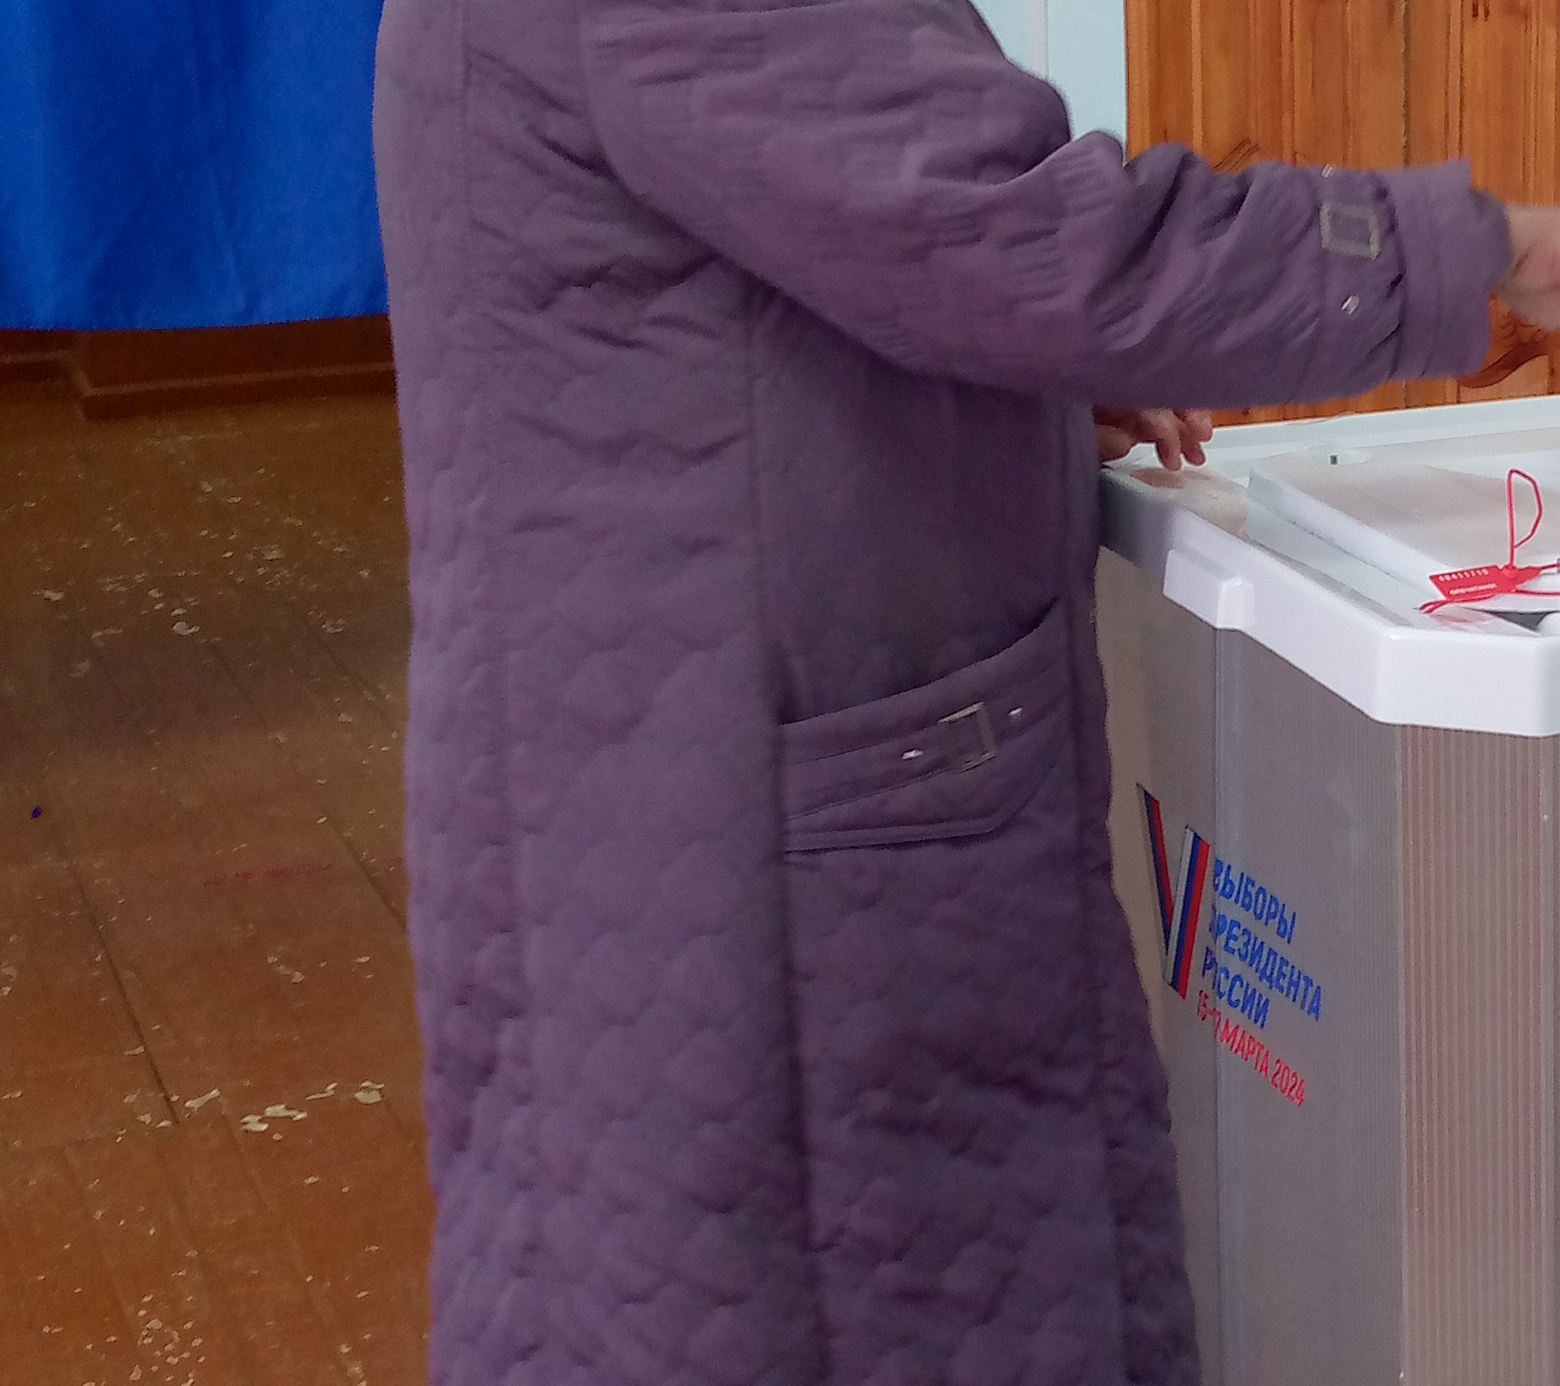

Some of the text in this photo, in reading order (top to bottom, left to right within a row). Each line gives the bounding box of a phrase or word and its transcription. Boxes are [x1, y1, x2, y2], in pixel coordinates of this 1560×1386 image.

[1214, 857, 1297, 944] ВЫБОРЫ
[1220, 1018, 1270, 1083] МАРТА
[1270, 1057, 1306, 1108] 2024
